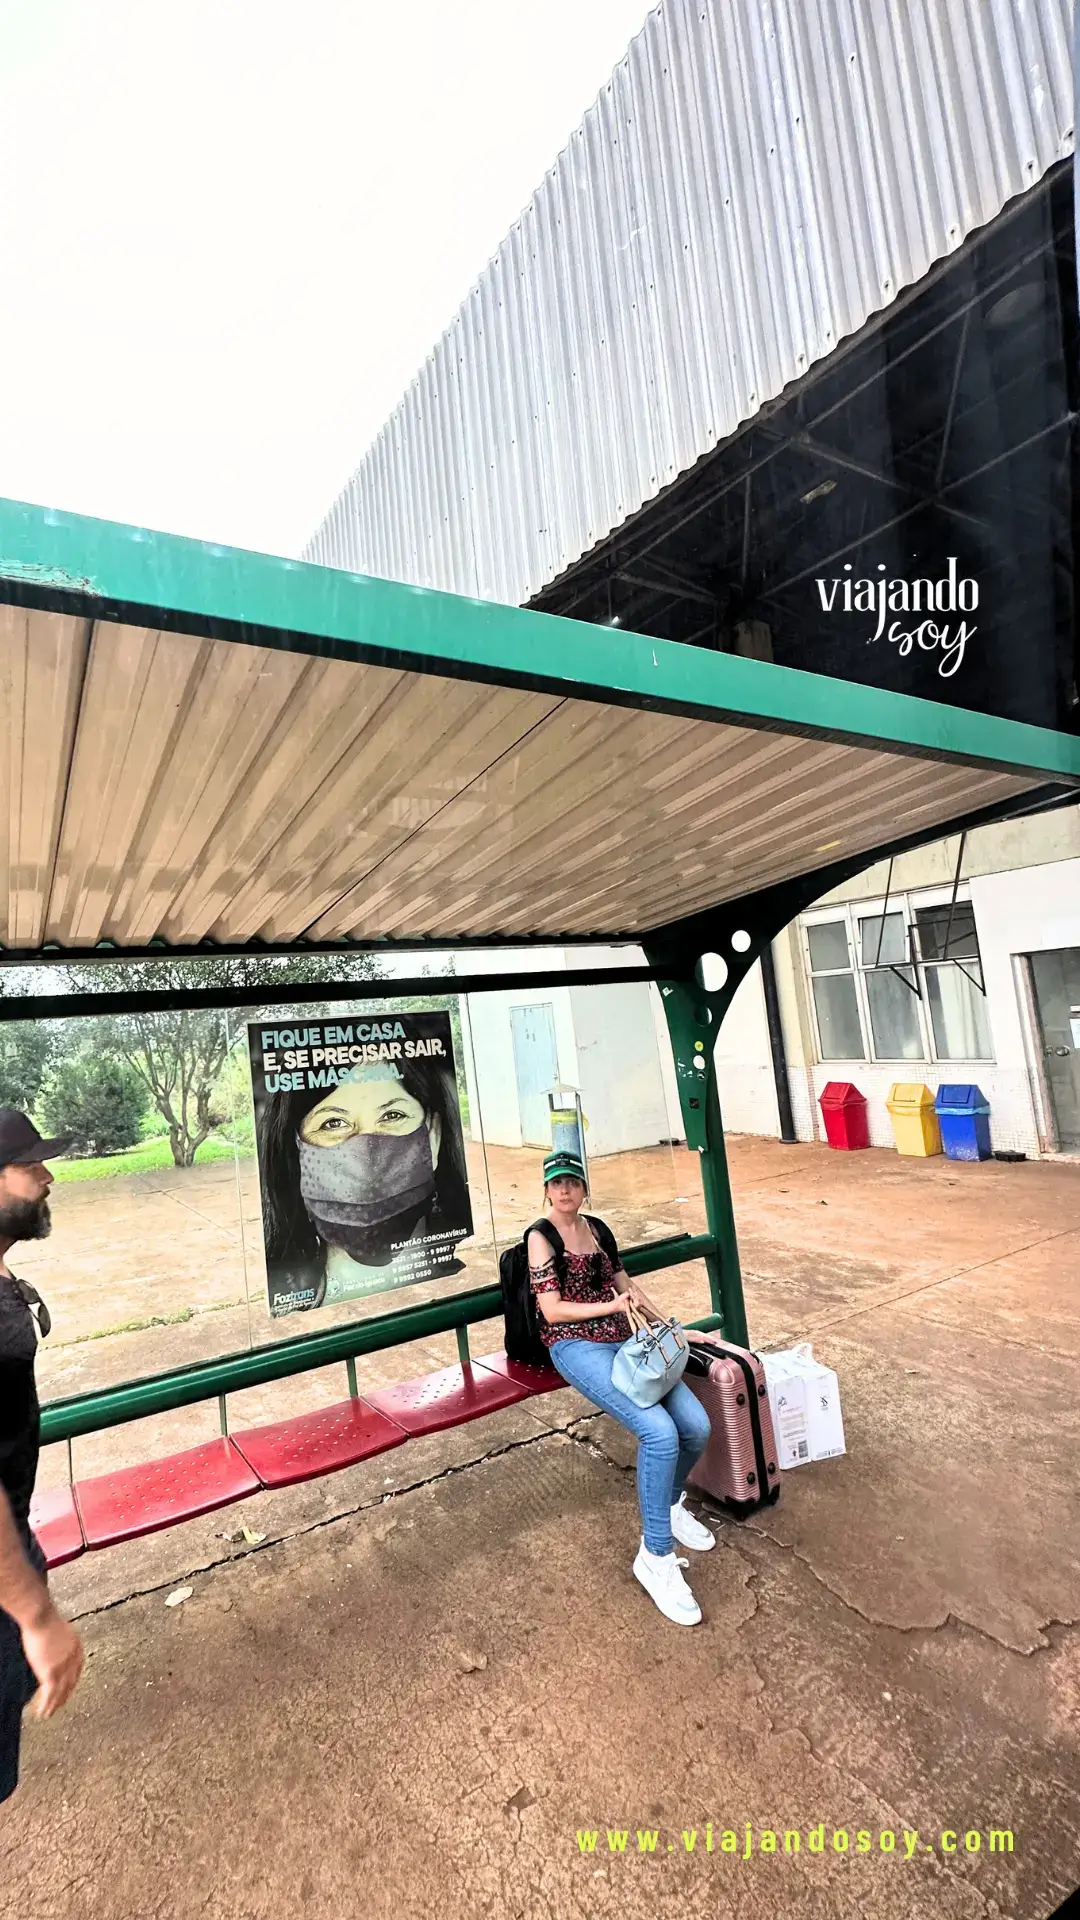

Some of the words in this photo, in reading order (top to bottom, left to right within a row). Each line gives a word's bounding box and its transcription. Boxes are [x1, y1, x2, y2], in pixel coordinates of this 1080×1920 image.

[261, 1027, 321, 1049] FIQUE
[324, 1025, 354, 1044] EM
[356, 1021, 406, 1042] CASA
[263, 1052, 282, 1073] E,
[284, 1049, 309, 1070] SE
[312, 1042, 401, 1067] PRECISAR
[404, 1038, 447, 1058] SAIR,
[264, 1072, 305, 1093] USE
[308, 1062, 404, 1090] MÁSCA.
[390, 1237, 422, 1250] PLANTÃO
[422, 1228, 467, 1243] CORONAVÍRUS
[273, 1288, 315, 1306] Foztrans
